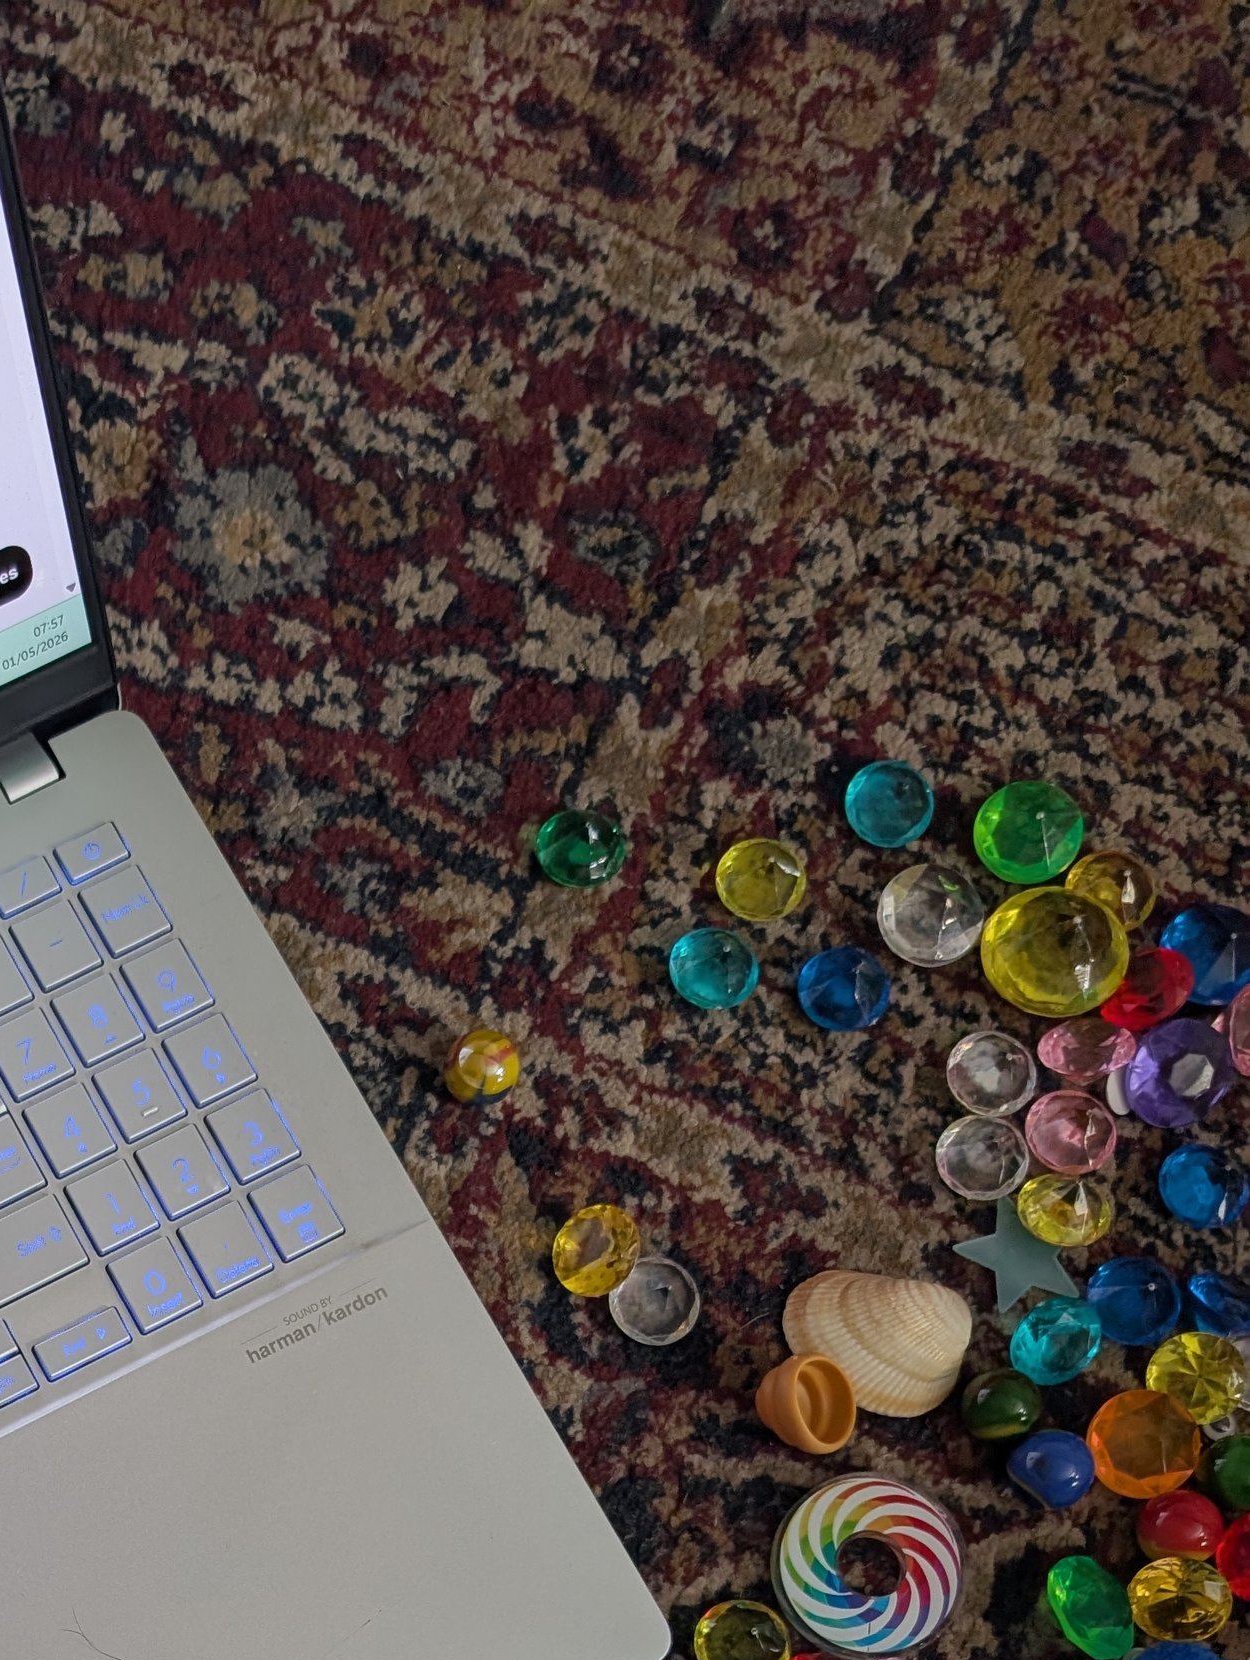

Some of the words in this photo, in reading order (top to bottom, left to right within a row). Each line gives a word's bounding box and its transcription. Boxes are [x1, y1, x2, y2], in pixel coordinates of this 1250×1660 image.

[33, 613, 65, 638] 07:57
[1, 631, 69, 671] 01/05/2026
[157, 968, 178, 993] 9
[87, 1002, 110, 1030] 8
[16, 1037, 33, 1066] 7
[202, 1046, 223, 1071] 6
[131, 1078, 152, 1108] 5
[62, 1114, 83, 1139] 4
[243, 1120, 265, 1147] 3
[170, 1157, 196, 1184] 2
[283, 1303, 320, 1327] SOUND
[319, 1295, 334, 1309] BY
